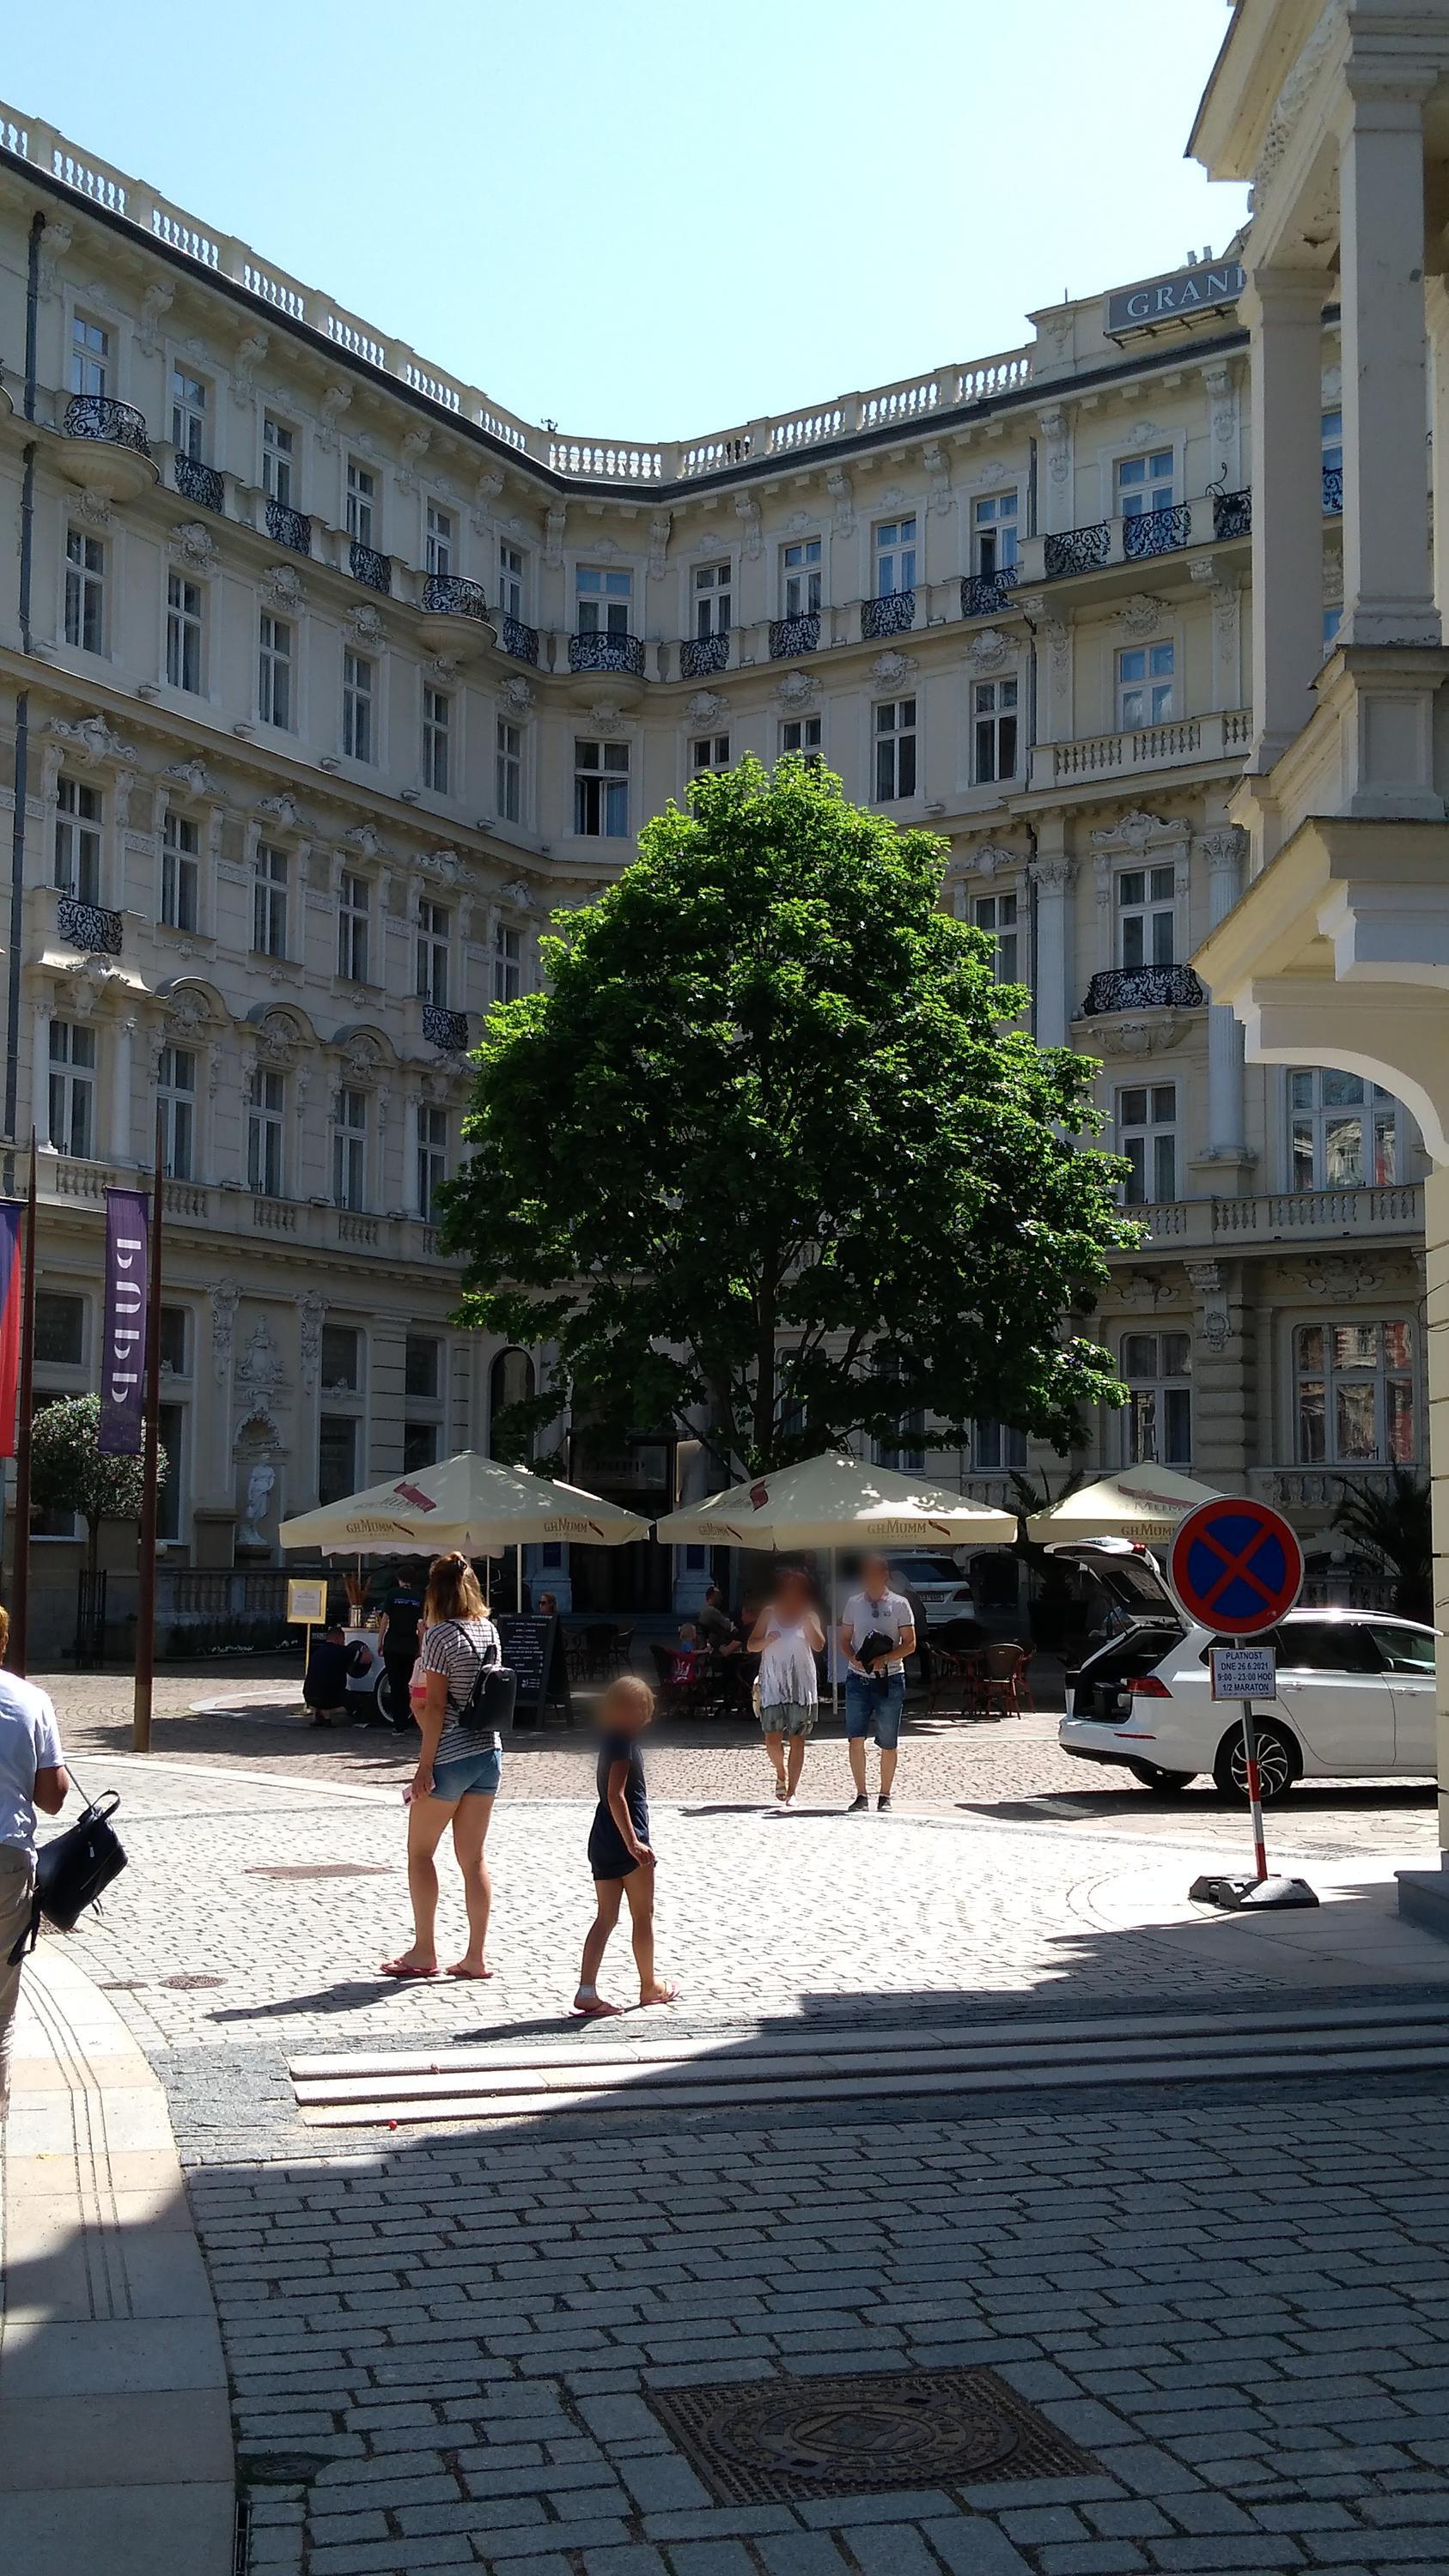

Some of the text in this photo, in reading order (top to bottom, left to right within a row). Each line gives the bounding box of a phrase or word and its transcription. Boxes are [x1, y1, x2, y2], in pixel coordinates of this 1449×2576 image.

[1226, 1651, 1263, 1660] PLATNOST
[1221, 1662, 1236, 1670] DNE
[1257, 1672, 1273, 1680] HOD
[1222, 1683, 1269, 1692] 1/2 MARATON
